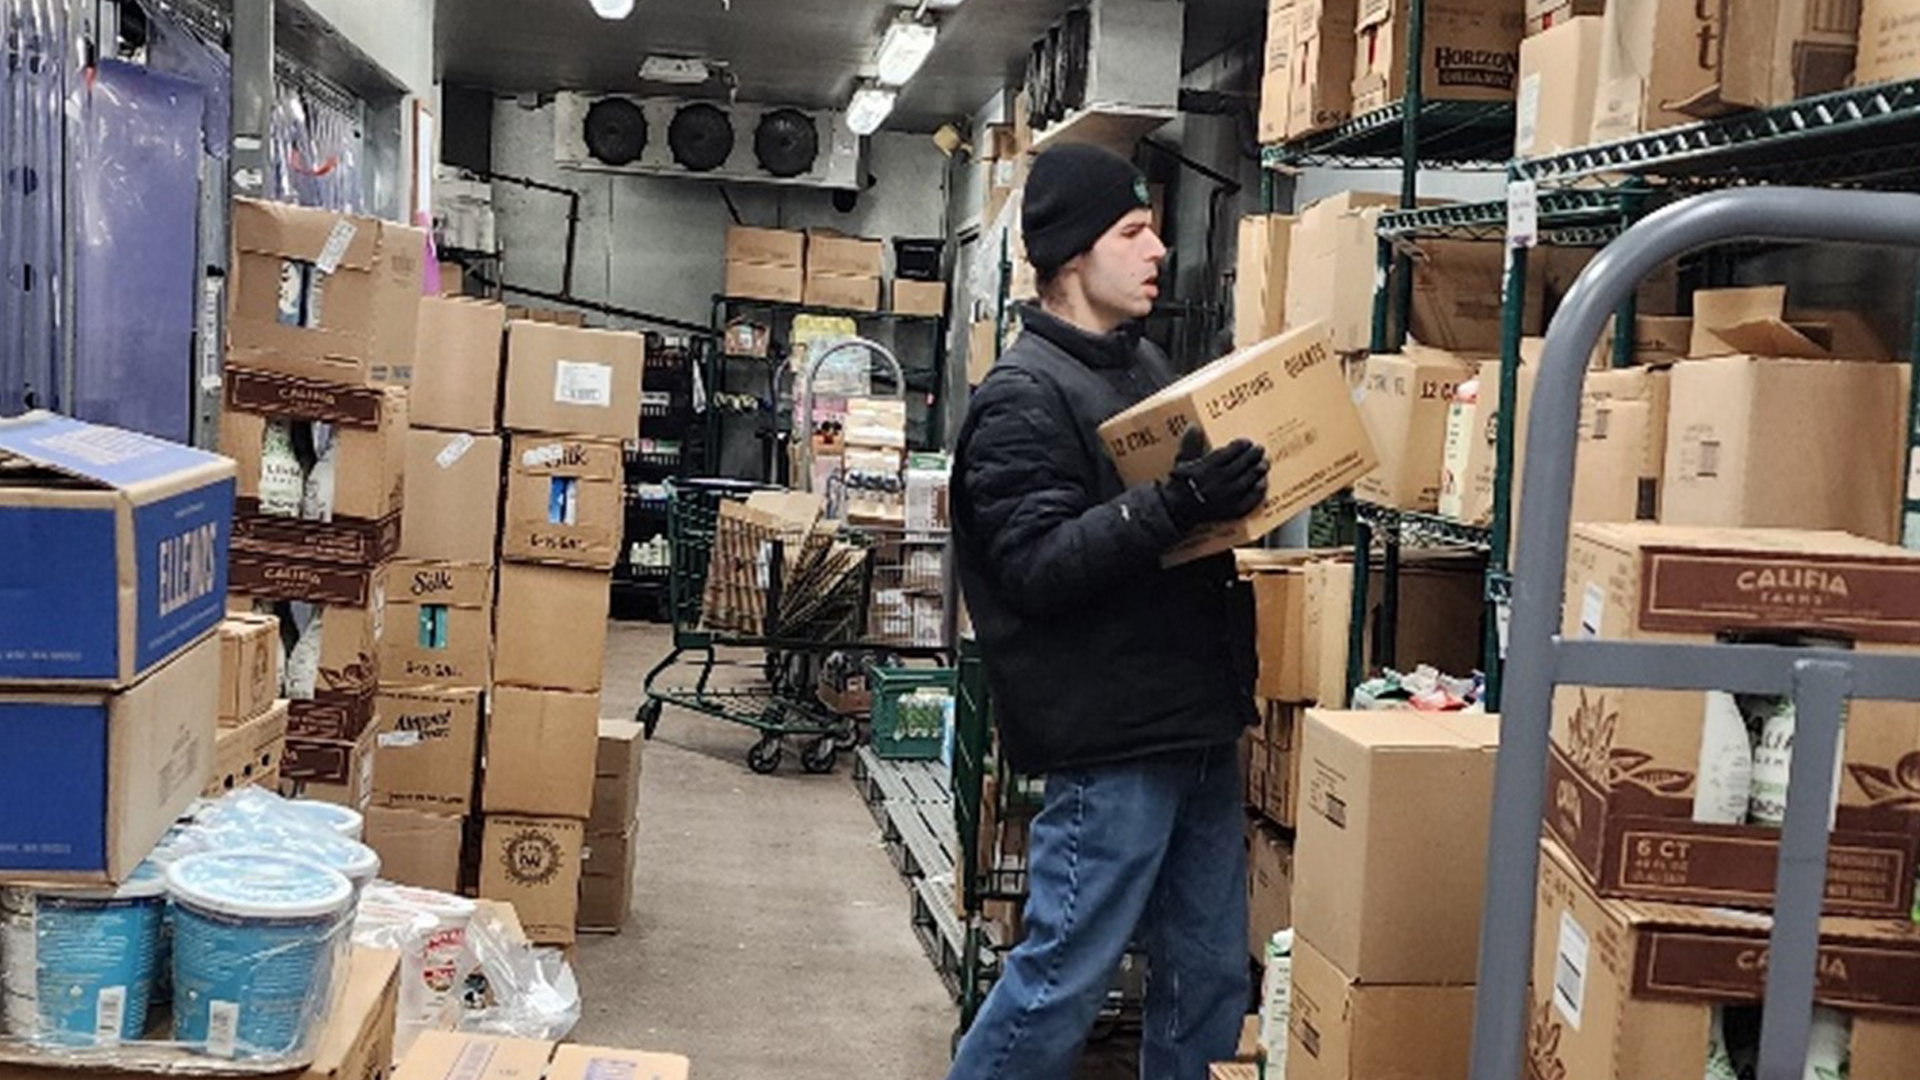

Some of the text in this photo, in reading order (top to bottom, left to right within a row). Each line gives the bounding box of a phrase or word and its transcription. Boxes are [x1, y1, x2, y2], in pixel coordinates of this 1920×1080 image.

[1435, 46, 1519, 74] HORIZON
[1283, 341, 1327, 379] QUARTS
[1421, 381, 1437, 399] 12
[410, 570, 454, 596] Silk
[1736, 568, 1850, 597] CALIFIA
[1760, 591, 1823, 606] FARMS
[1637, 840, 1691, 859] 6 CT
